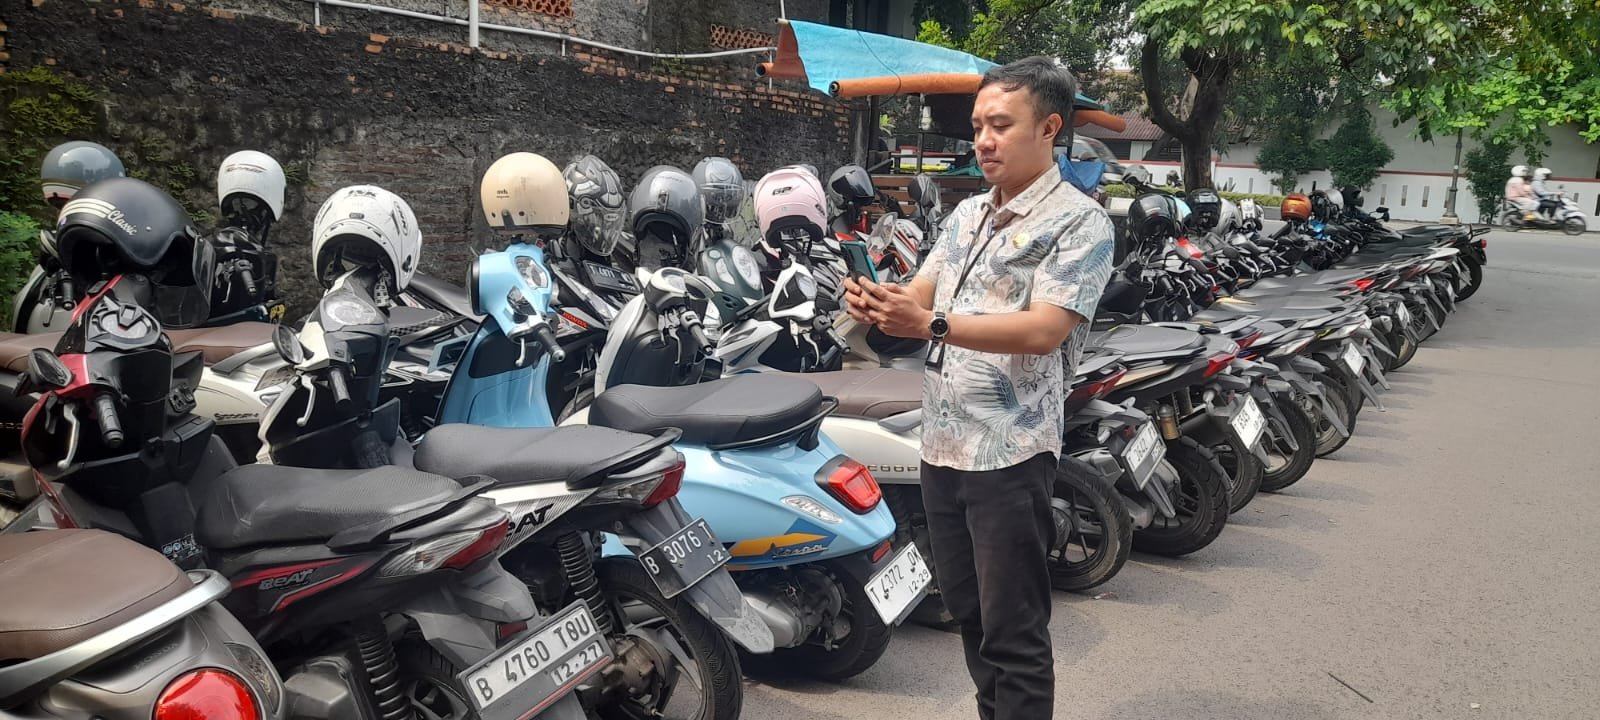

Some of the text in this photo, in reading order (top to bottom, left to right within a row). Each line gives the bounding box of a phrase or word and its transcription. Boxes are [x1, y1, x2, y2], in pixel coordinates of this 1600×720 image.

[108, 210, 137, 235] Classic
[562, 311, 589, 329] HONDA
[645, 556, 660, 576] B
[663, 530, 702, 565] 3076
[869, 586, 880, 604] T
[880, 564, 904, 595] 4372
[476, 674, 494, 702] B
[504, 640, 550, 684] 4760
